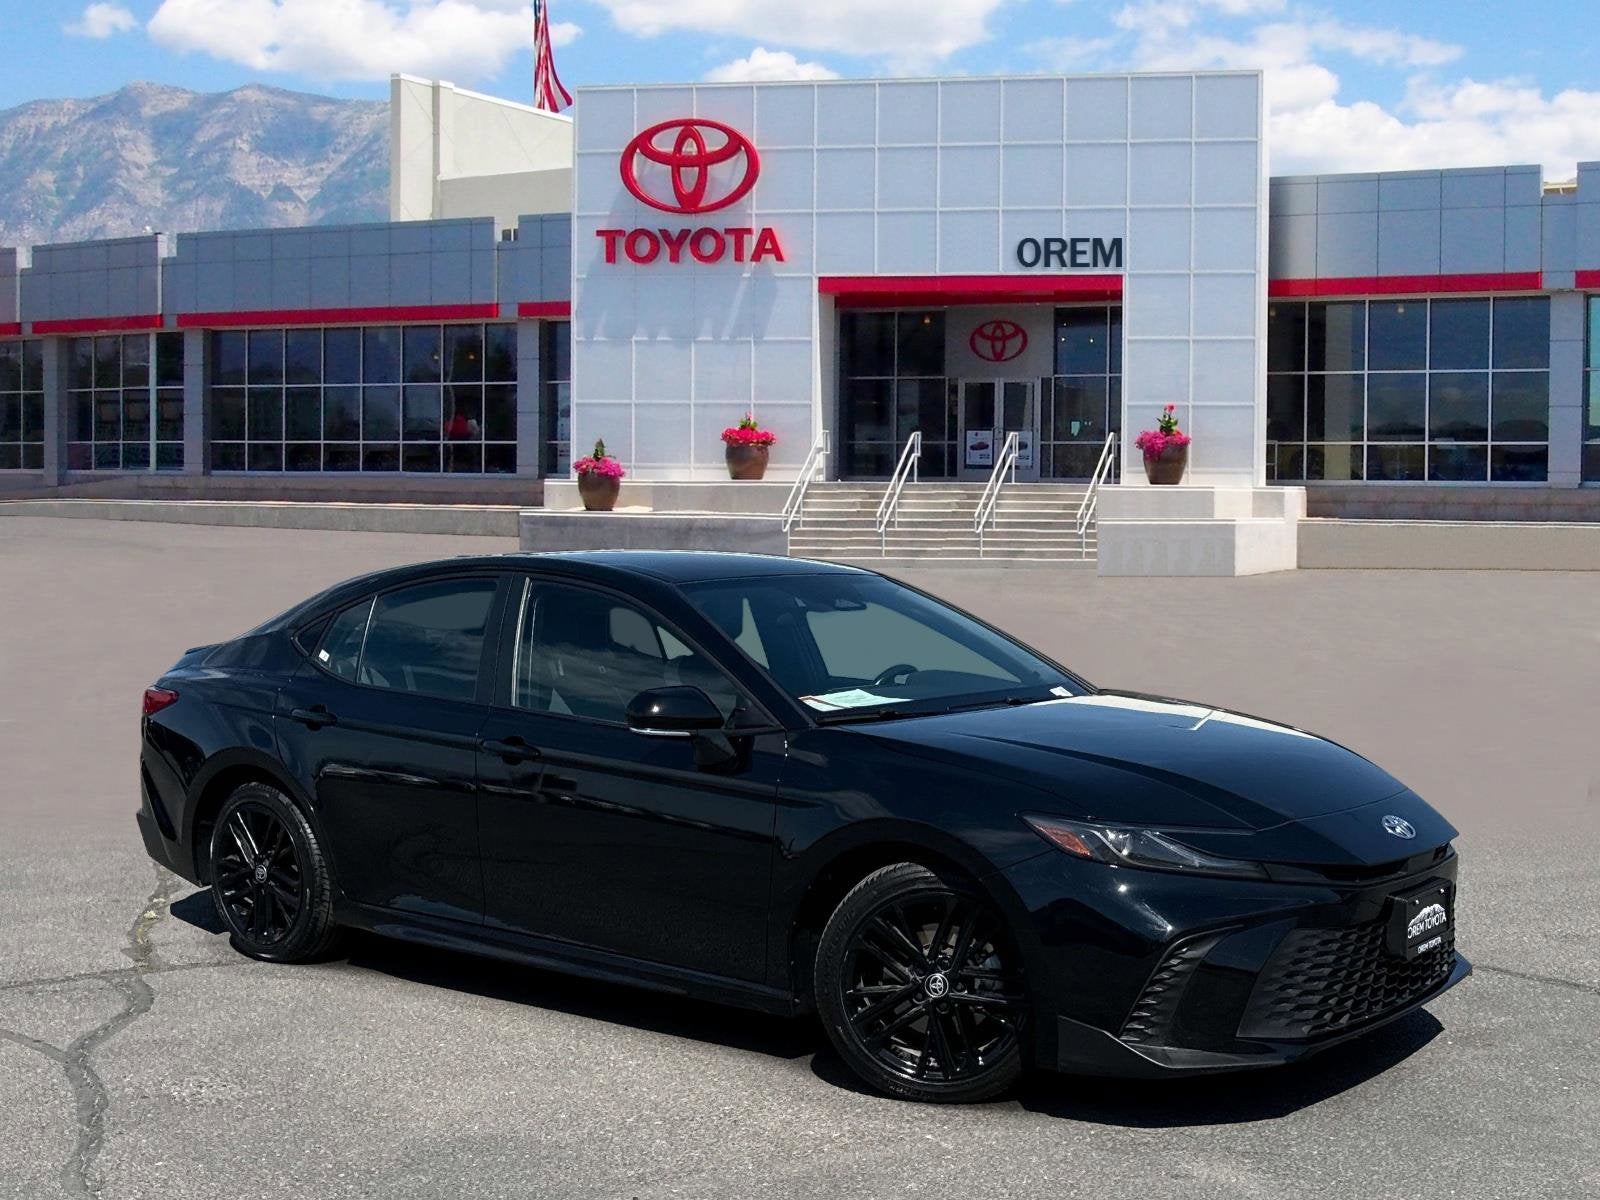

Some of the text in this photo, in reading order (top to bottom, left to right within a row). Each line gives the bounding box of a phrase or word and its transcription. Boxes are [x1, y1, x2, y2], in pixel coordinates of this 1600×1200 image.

[596, 227, 785, 264] TOYOTA
[1017, 237, 1123, 269] OREM
[1408, 911, 1447, 939] OREM TOYOTA
